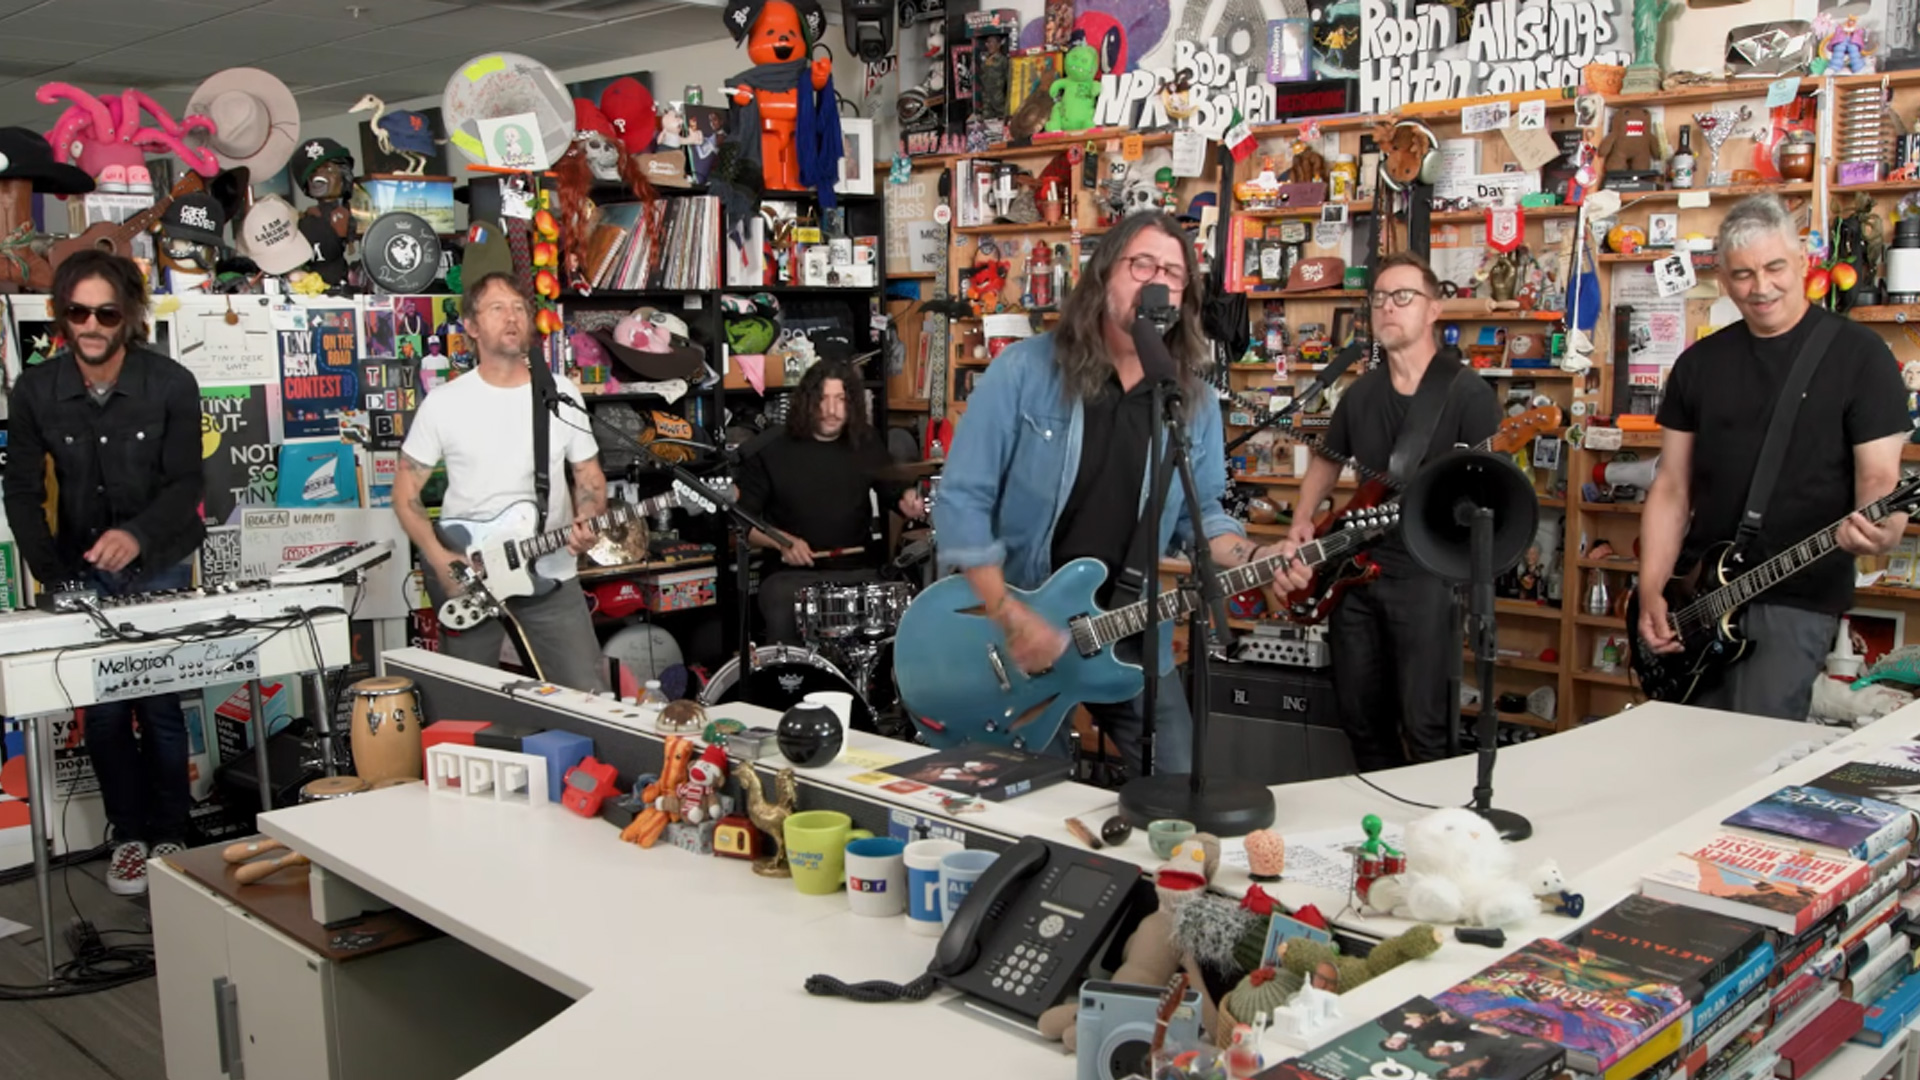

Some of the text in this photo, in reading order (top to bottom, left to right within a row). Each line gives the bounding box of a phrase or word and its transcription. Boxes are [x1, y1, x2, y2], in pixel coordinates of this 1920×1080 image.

[1360, 0, 1451, 59] Robin
[1467, 0, 1615, 68] Allsongs
[1176, 37, 1231, 86] Bob
[1094, 68, 1178, 127] NPR
[1360, 51, 1471, 116] Hilton
[1189, 67, 1277, 140] Boilen
[323, 333, 354, 351] ON THE
[327, 350, 352, 366] ROAD
[284, 375, 342, 399] CONTEST
[229, 444, 276, 464] NOT
[248, 466, 278, 483] SO
[203, 534, 236, 549] NICK
[1694, 847, 1834, 885] HOW WOMEN
[1707, 838, 1848, 875] MADE MUSIC
[851, 877, 884, 892] npr
[1591, 928, 1714, 964] METALLICA
[1696, 995, 1727, 1028] DYLAN
